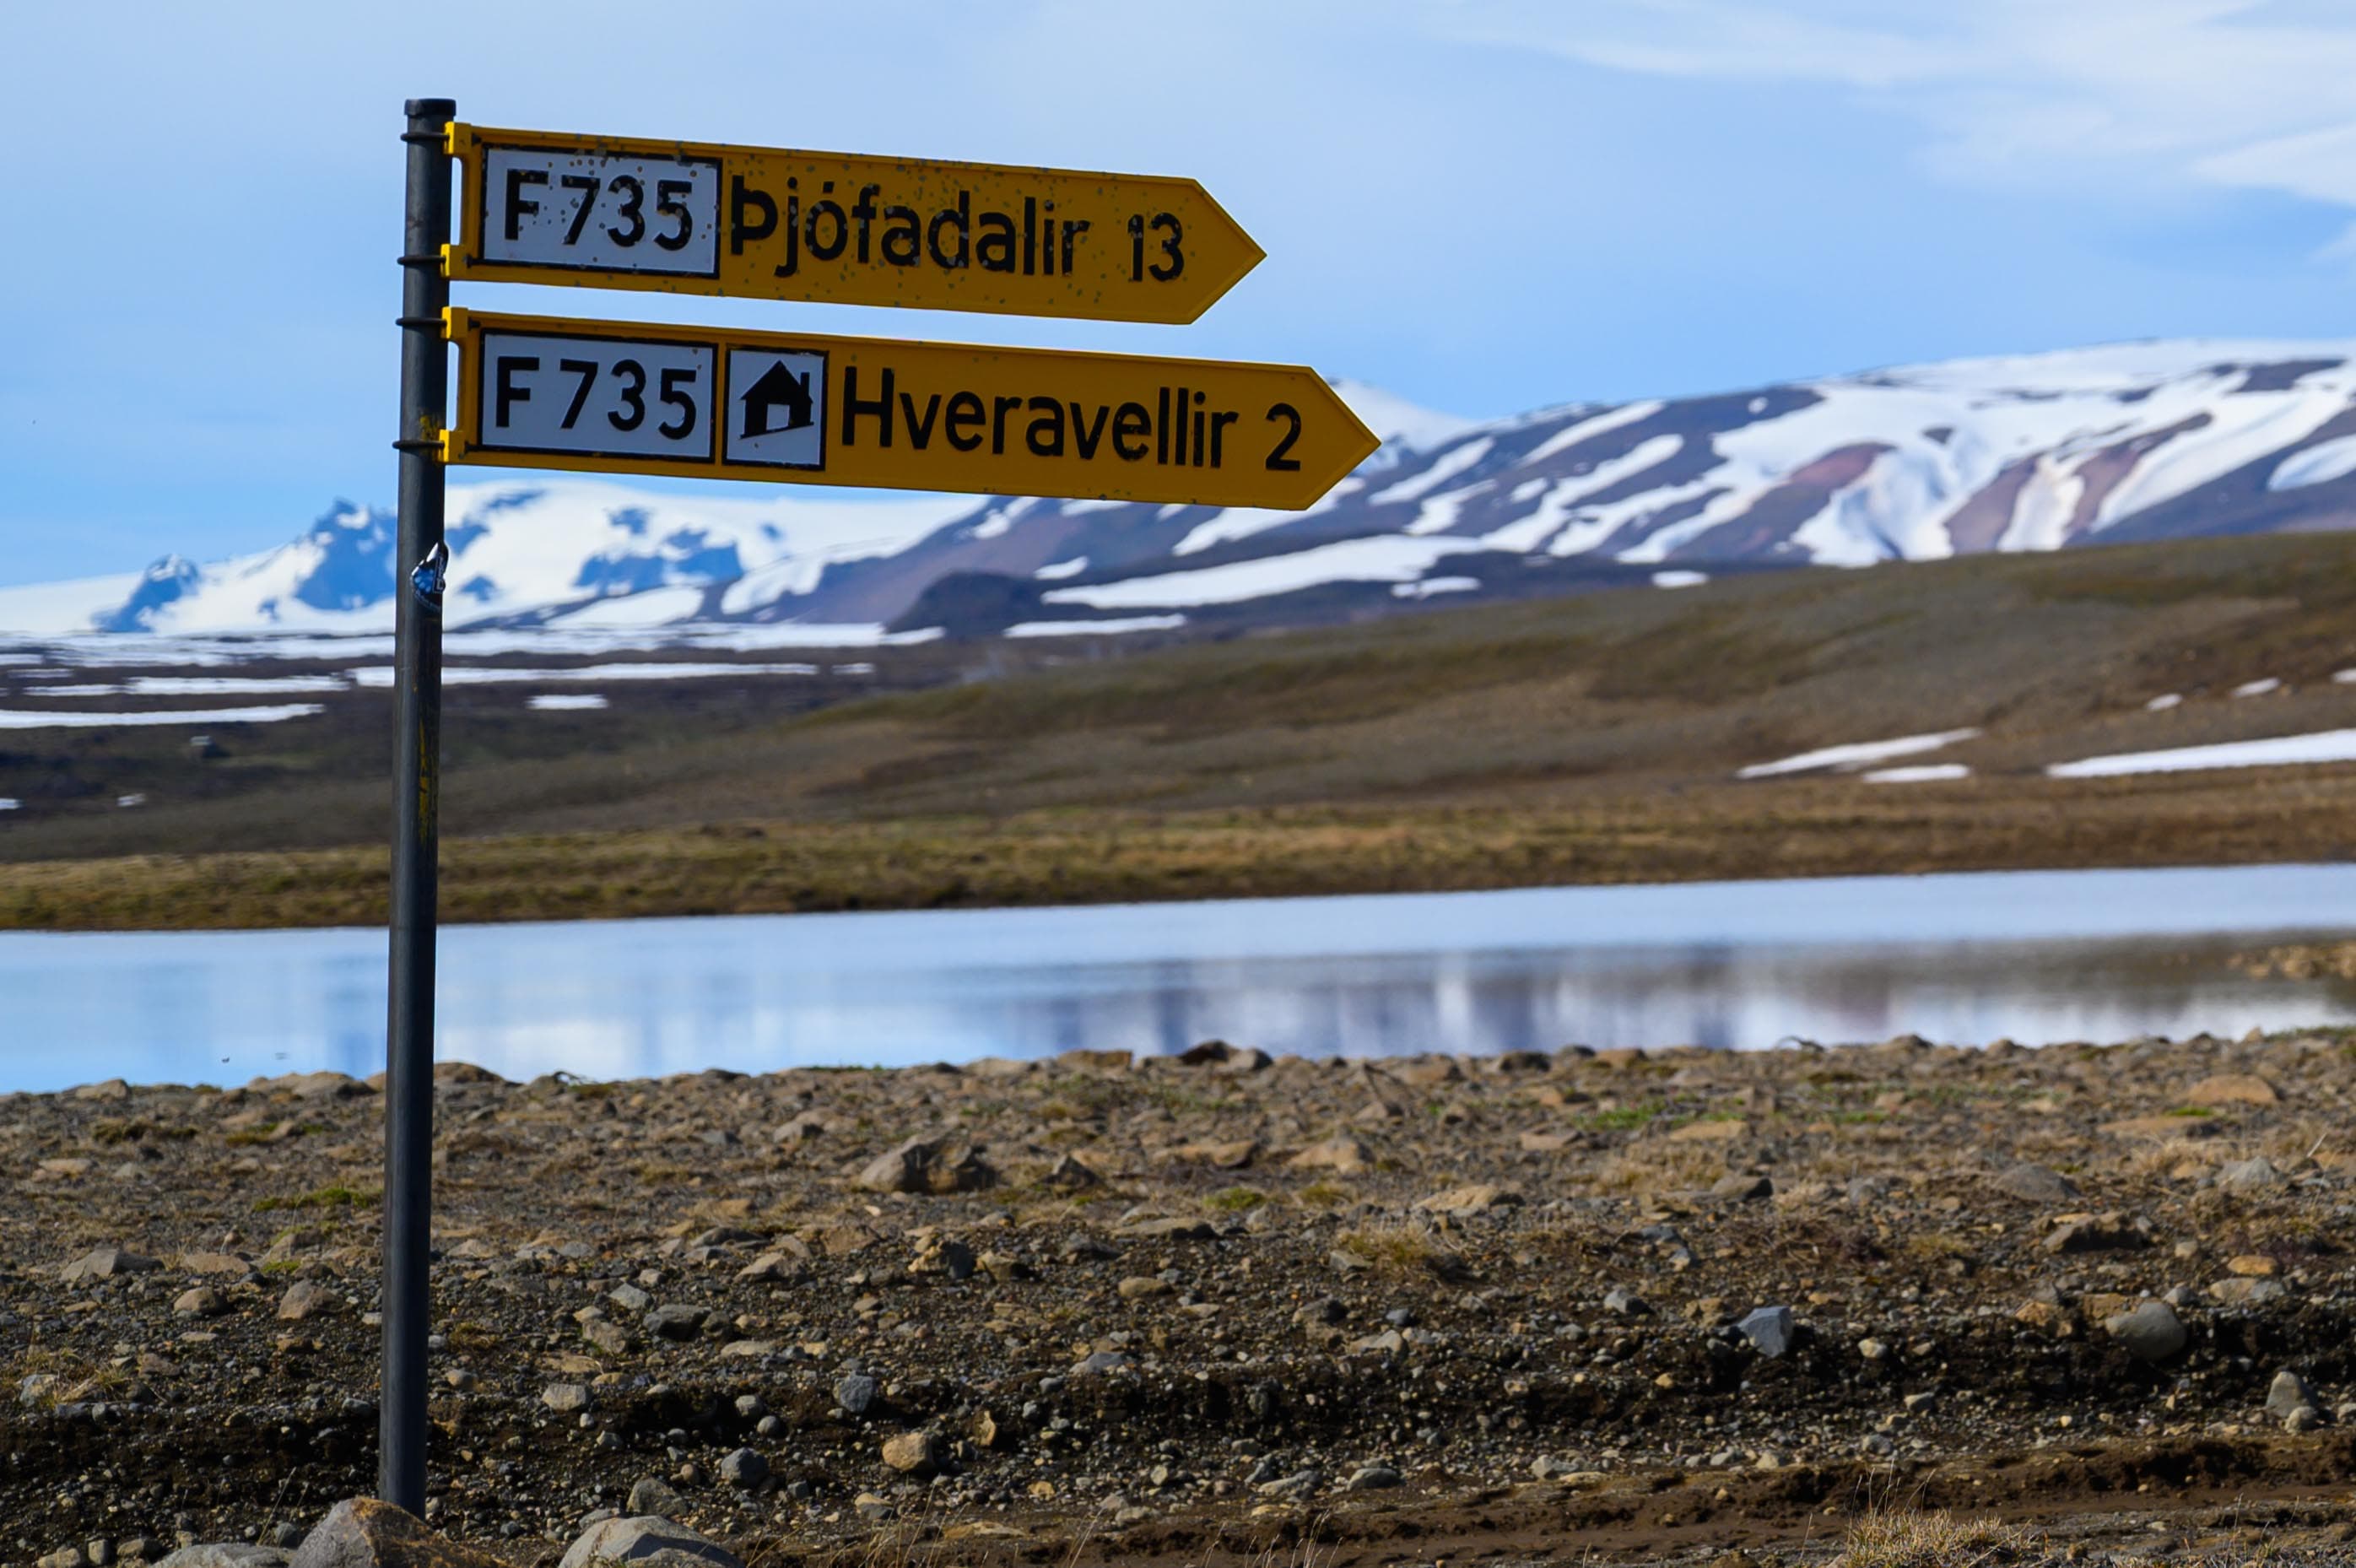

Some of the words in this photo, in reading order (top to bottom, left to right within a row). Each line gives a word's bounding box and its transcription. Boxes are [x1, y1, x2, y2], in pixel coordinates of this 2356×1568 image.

[504, 168, 694, 251] F735
[729, 174, 1091, 278] Þjófadalir
[1127, 211, 1186, 283] 13
[840, 365, 1240, 469] Hveravellir
[1265, 402, 1302, 472] 2
